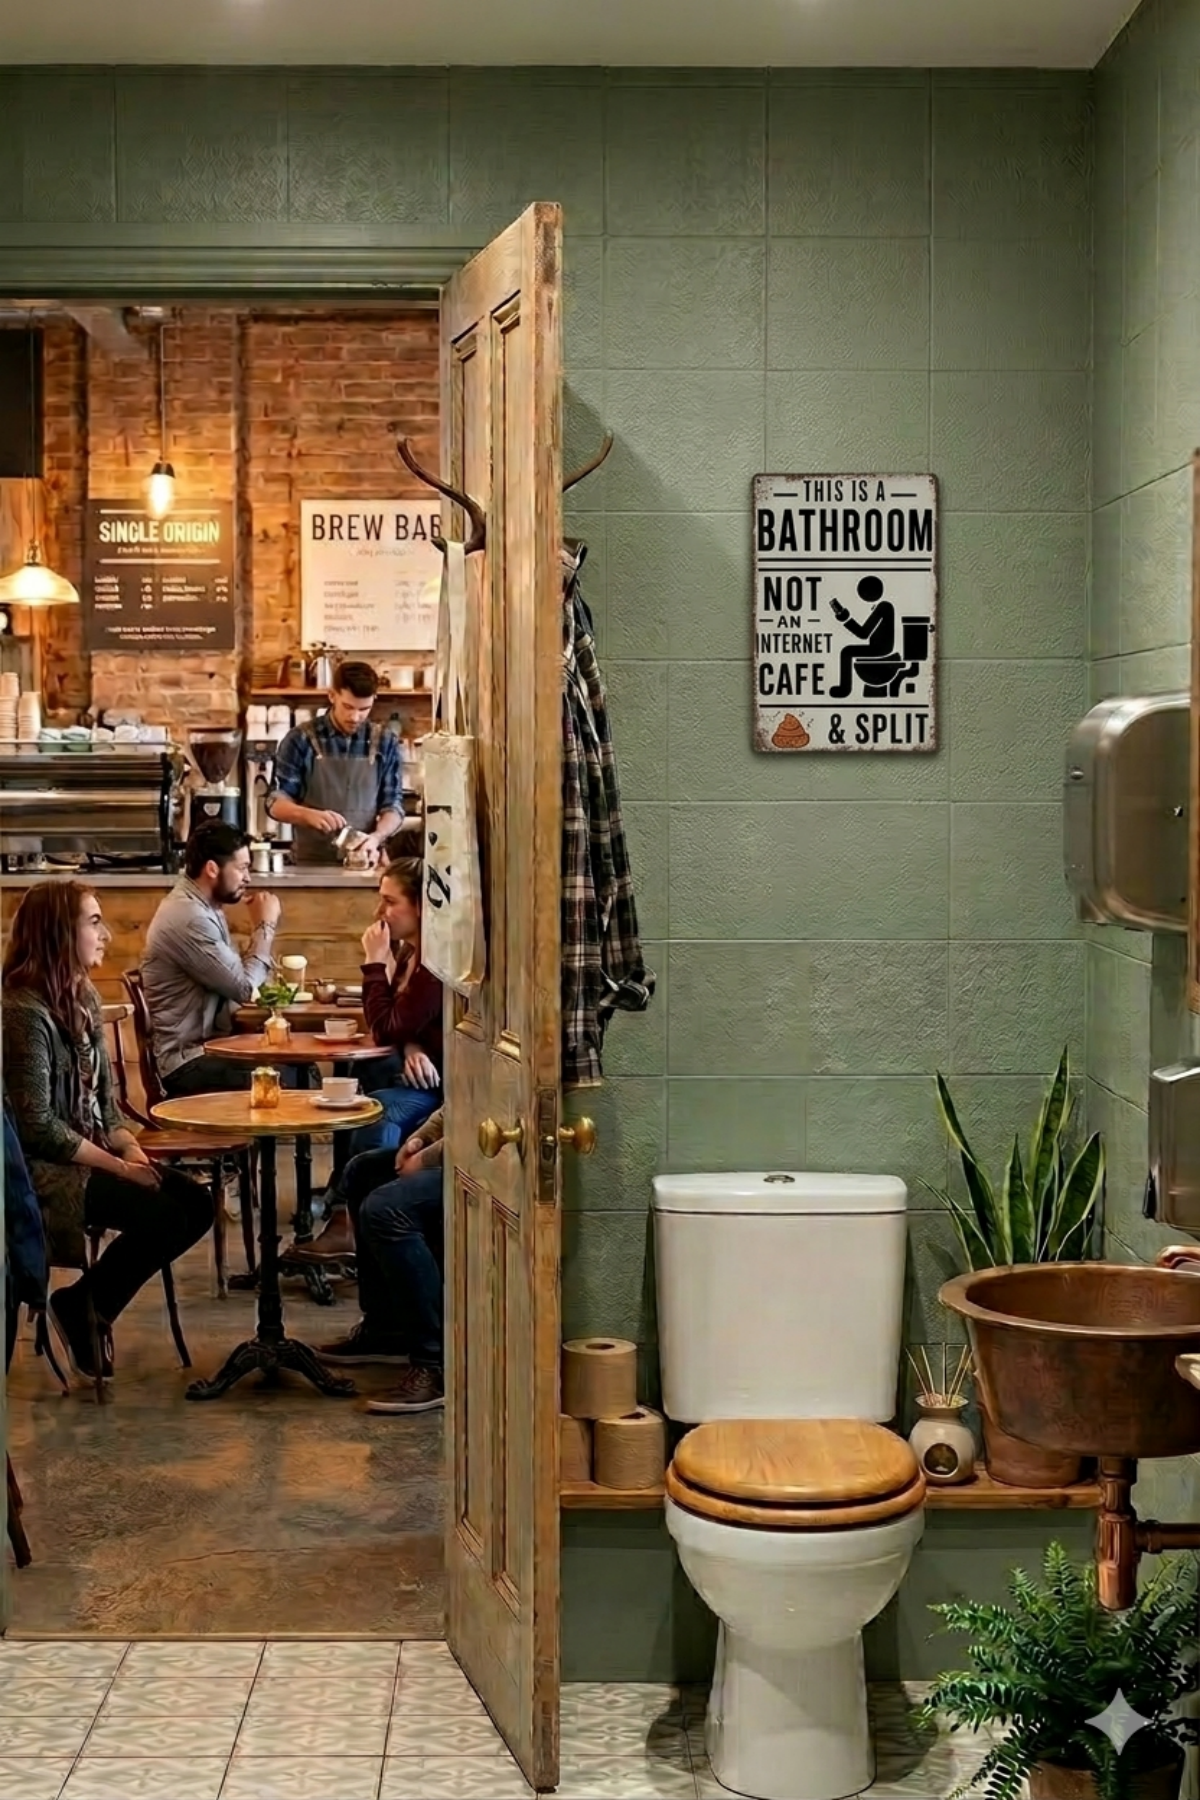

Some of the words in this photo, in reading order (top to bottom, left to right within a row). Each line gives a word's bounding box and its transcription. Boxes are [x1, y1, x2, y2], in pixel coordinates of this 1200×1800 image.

[803, 480, 844, 502] THIS
[851, 480, 868, 502] IS
[876, 480, 886, 502] A
[99, 520, 160, 543] SINGLE
[163, 520, 220, 543] ORIGIN
[312, 513, 384, 541] BREW
[757, 508, 933, 552] BATHROOM
[763, 576, 822, 612] NOT
[777, 615, 801, 629] AN
[756, 633, 833, 653] INTERNET
[759, 662, 825, 696] CAFE
[828, 713, 846, 745] &
[855, 713, 929, 745] SPLIT
